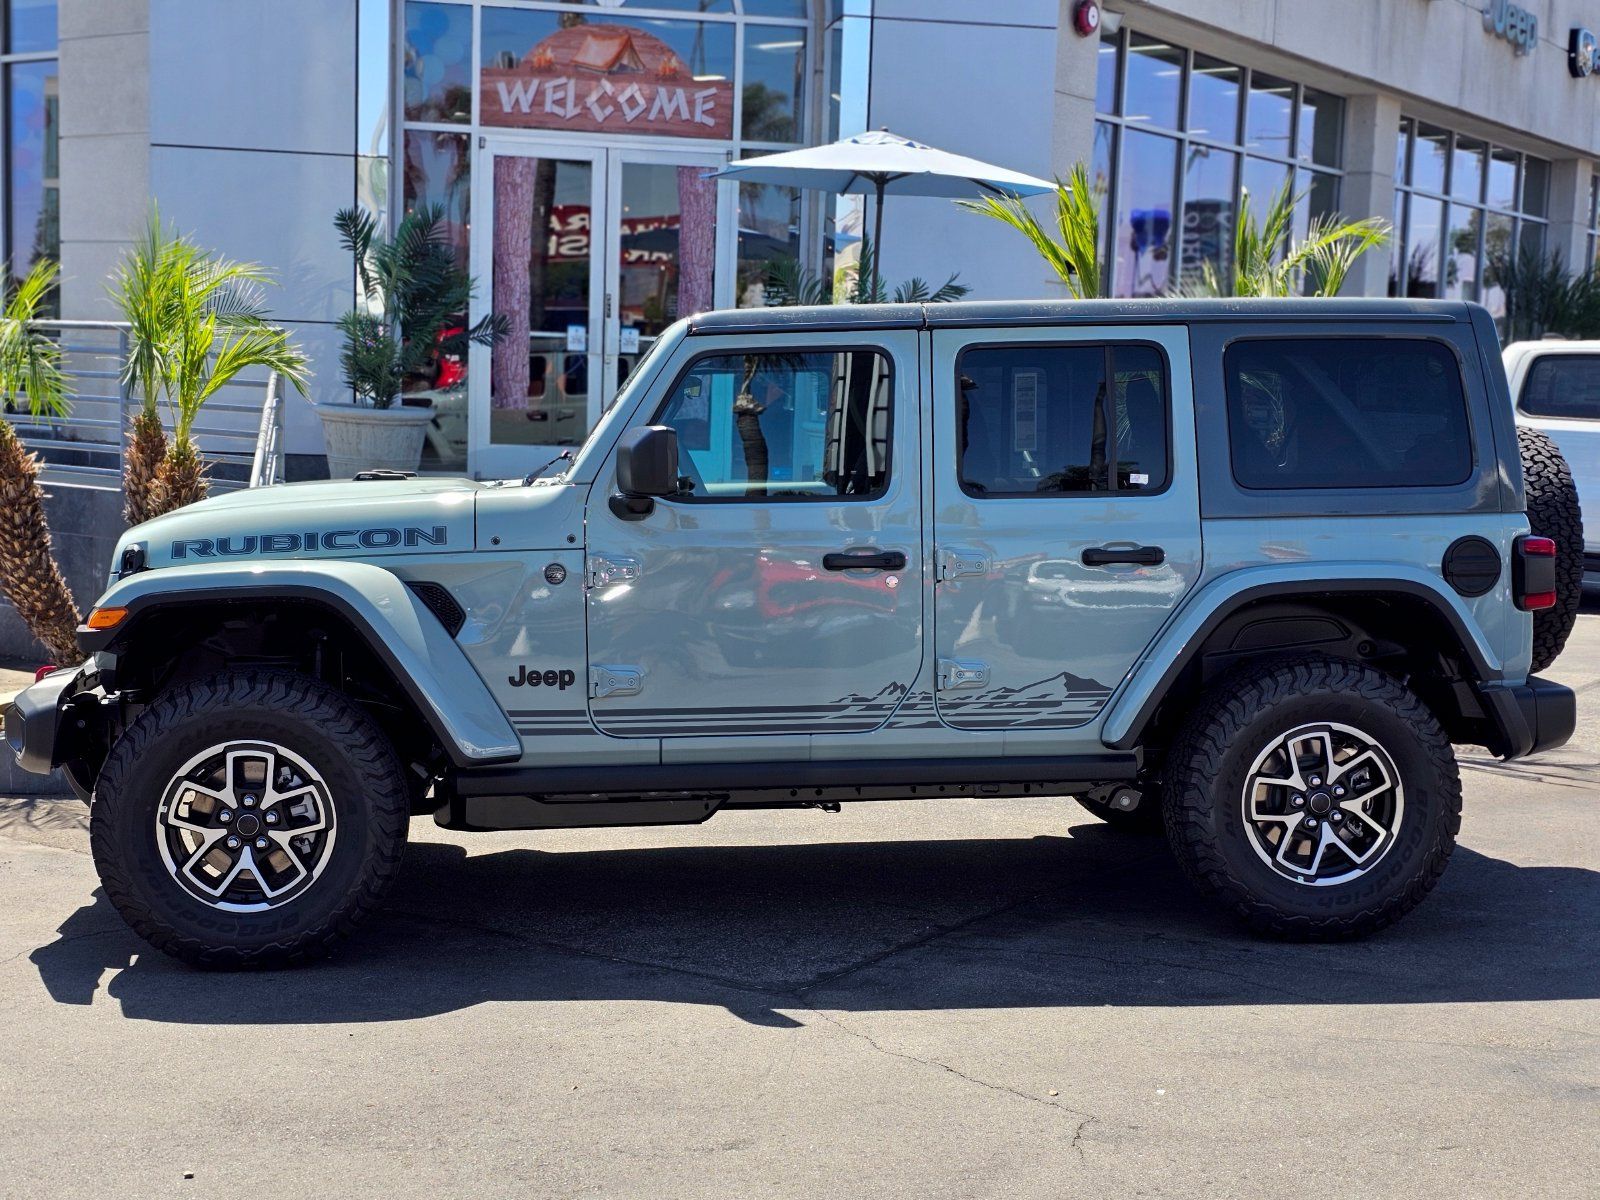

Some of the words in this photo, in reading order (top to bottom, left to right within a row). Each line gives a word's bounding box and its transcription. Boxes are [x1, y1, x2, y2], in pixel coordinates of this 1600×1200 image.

[1483, 0, 1537, 57] Jeep
[496, 76, 718, 128] WELCOME
[171, 526, 447, 559] RUBICON
[508, 665, 575, 690] Jeep
